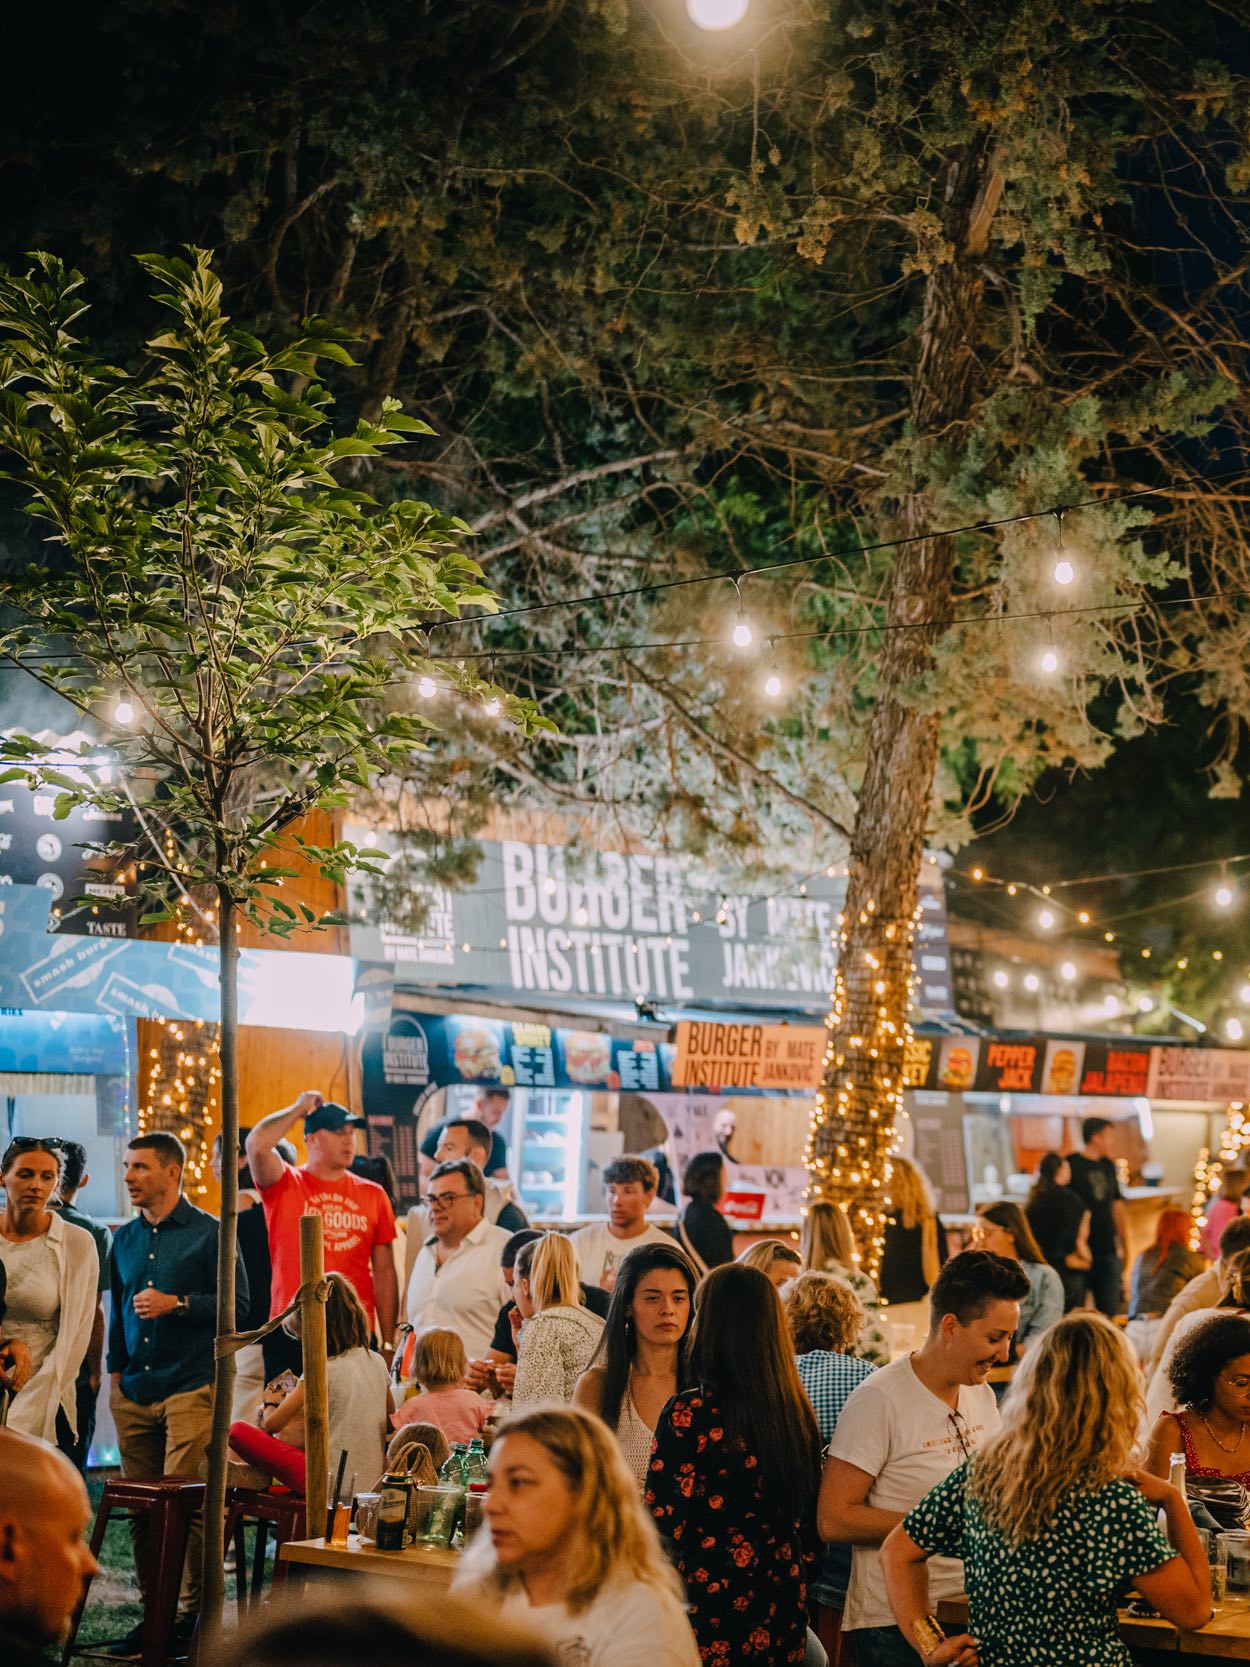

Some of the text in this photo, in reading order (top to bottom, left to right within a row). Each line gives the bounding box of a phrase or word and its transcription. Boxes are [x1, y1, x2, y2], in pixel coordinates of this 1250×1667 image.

[87, 921, 126, 936] TASTE
[33, 956, 76, 988] smash
[507, 925, 694, 999] INSTITUTE
[110, 986, 149, 1013] smash
[688, 1022, 816, 1059] BURGER BY MATE
[987, 1043, 1037, 1067] PEPPER
[684, 1059, 760, 1087] INSTITUTE
[998, 1066, 1033, 1089] JACK
[324, 1211, 368, 1232] GOODS
